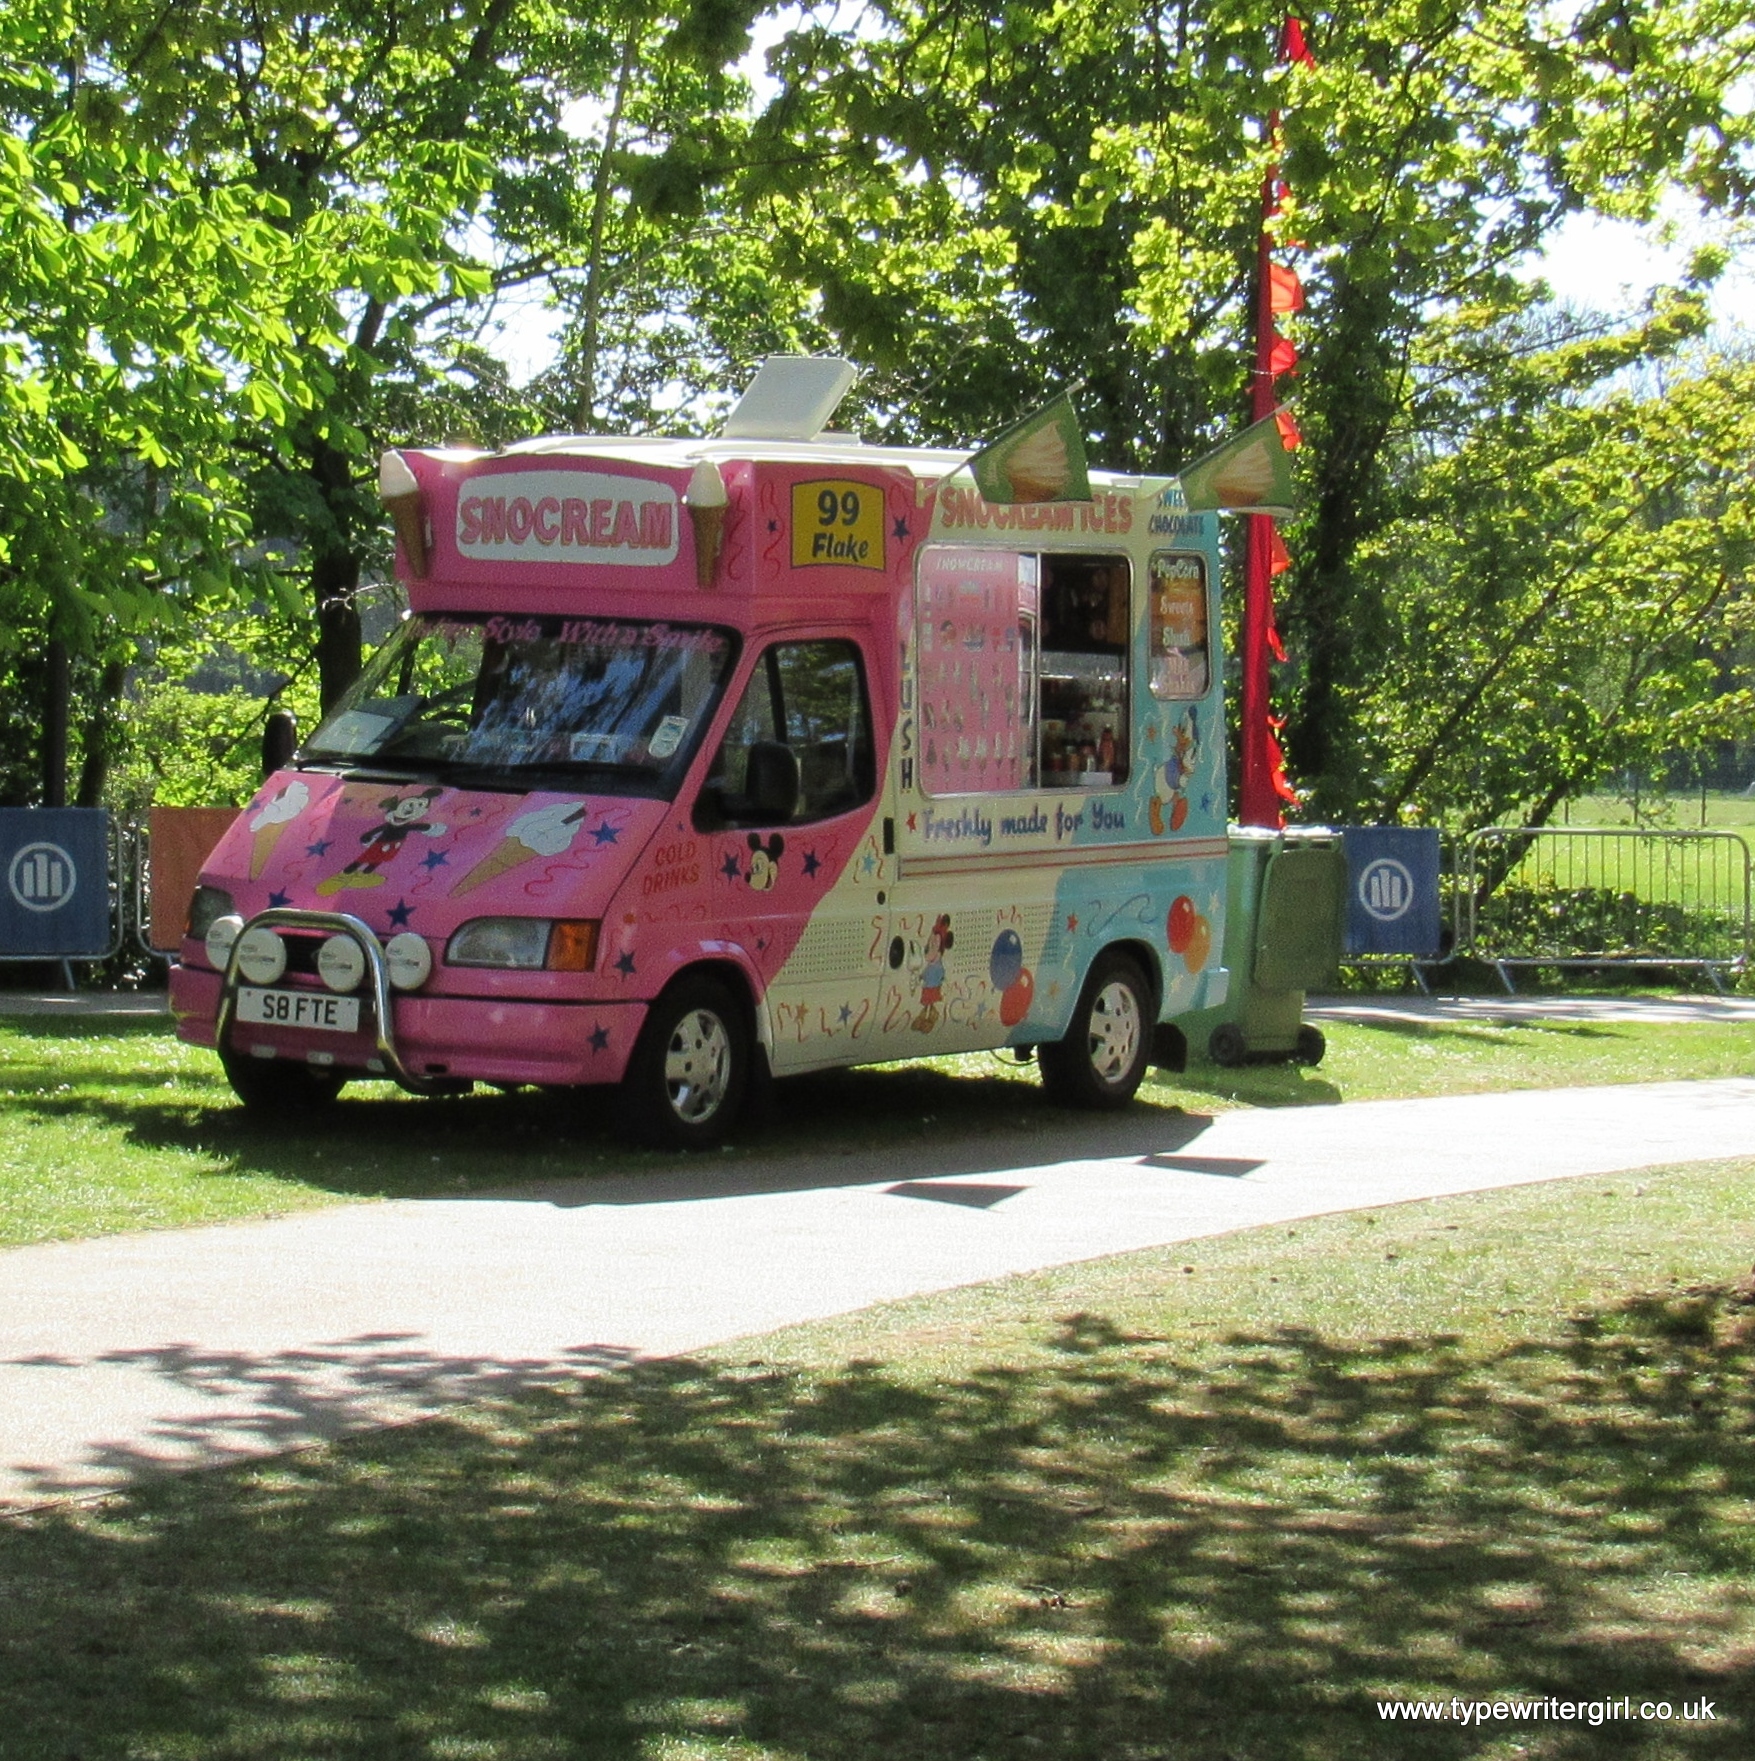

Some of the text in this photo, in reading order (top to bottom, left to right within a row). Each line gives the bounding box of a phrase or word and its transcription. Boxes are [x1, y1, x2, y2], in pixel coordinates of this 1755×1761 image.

[459, 496, 672, 549] SNOCREAM
[817, 489, 860, 527] 99
[1080, 493, 1133, 534] ICES
[1147, 513, 1205, 537] CHOCOLATE
[811, 532, 869, 562] Flake
[922, 801, 1126, 846] Freshly made for You
[655, 840, 696, 867] COLD
[642, 863, 700, 896] DRINKS
[262, 994, 338, 1025] S8 FTE
